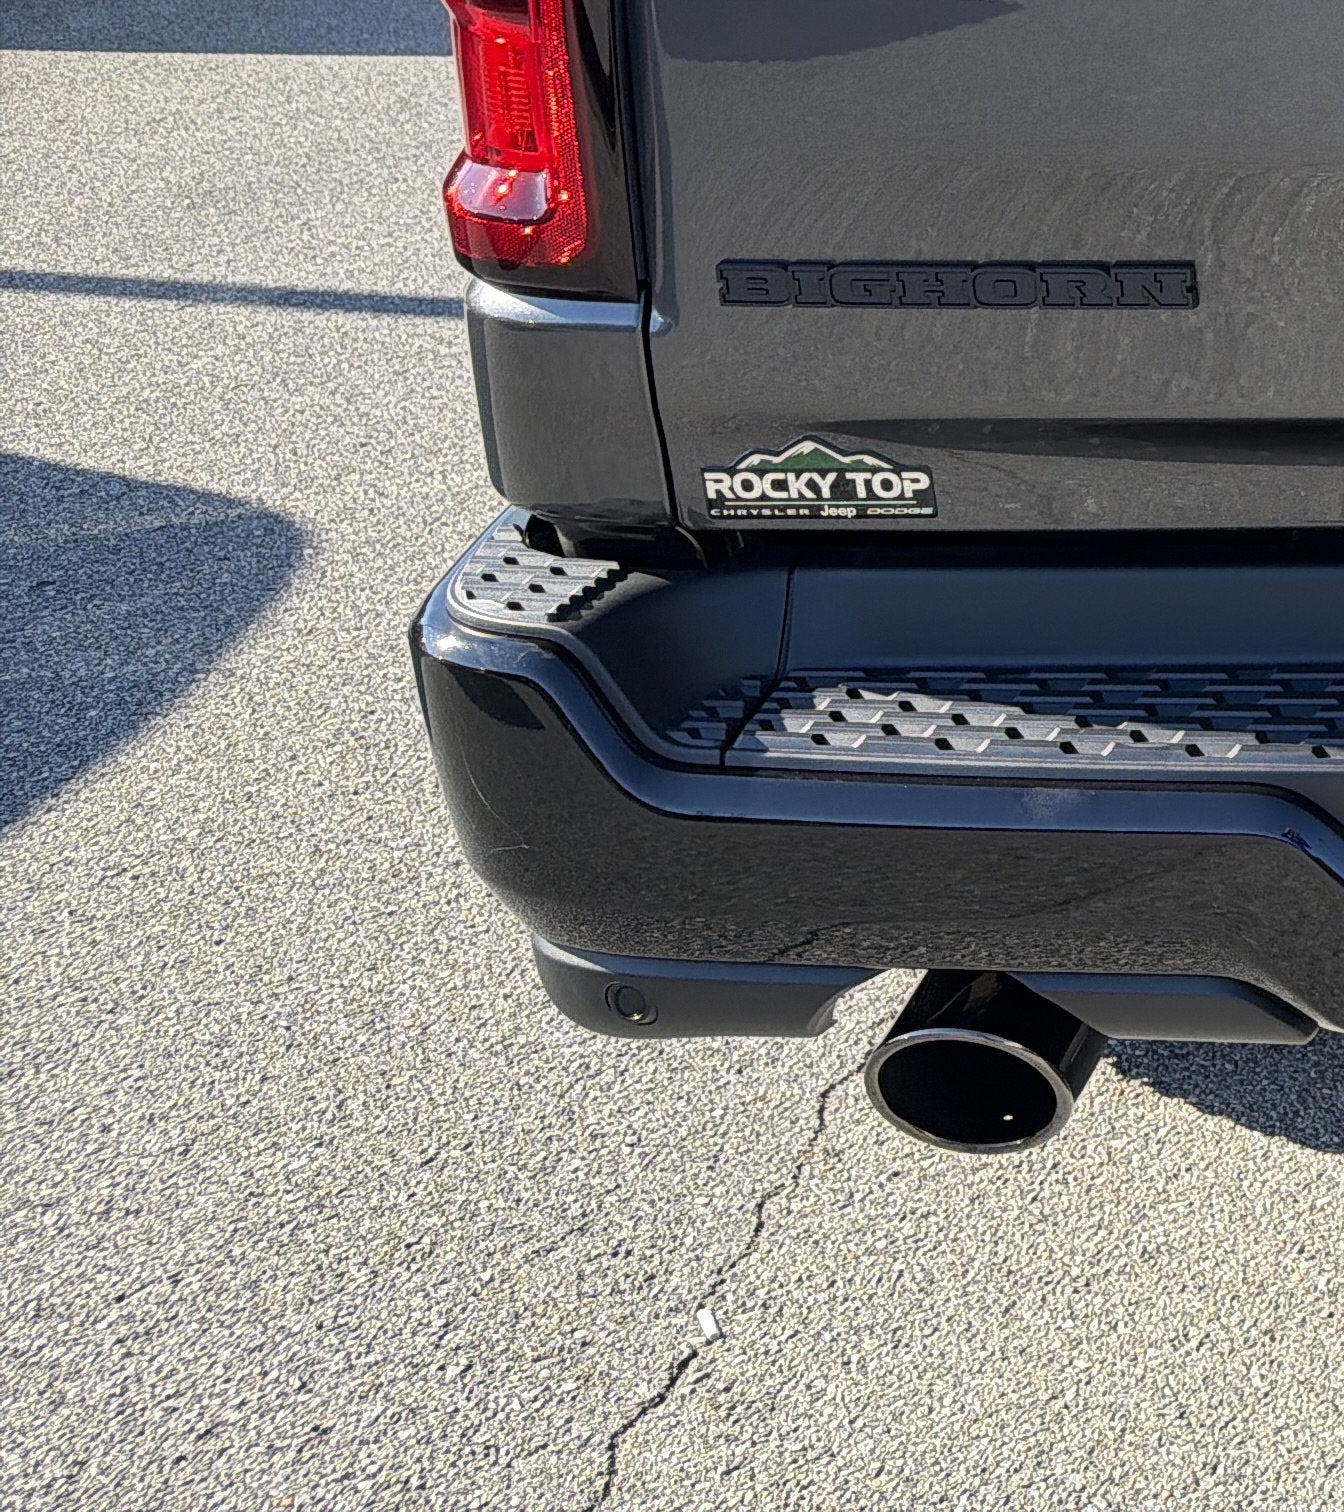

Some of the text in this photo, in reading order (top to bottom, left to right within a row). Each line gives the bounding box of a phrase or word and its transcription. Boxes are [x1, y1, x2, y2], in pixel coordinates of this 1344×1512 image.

[716, 259, 1200, 309] BIGHORN
[703, 470, 931, 500] ROCKY TOP
[709, 504, 935, 519] CHRYSLER Jeep DODGE
